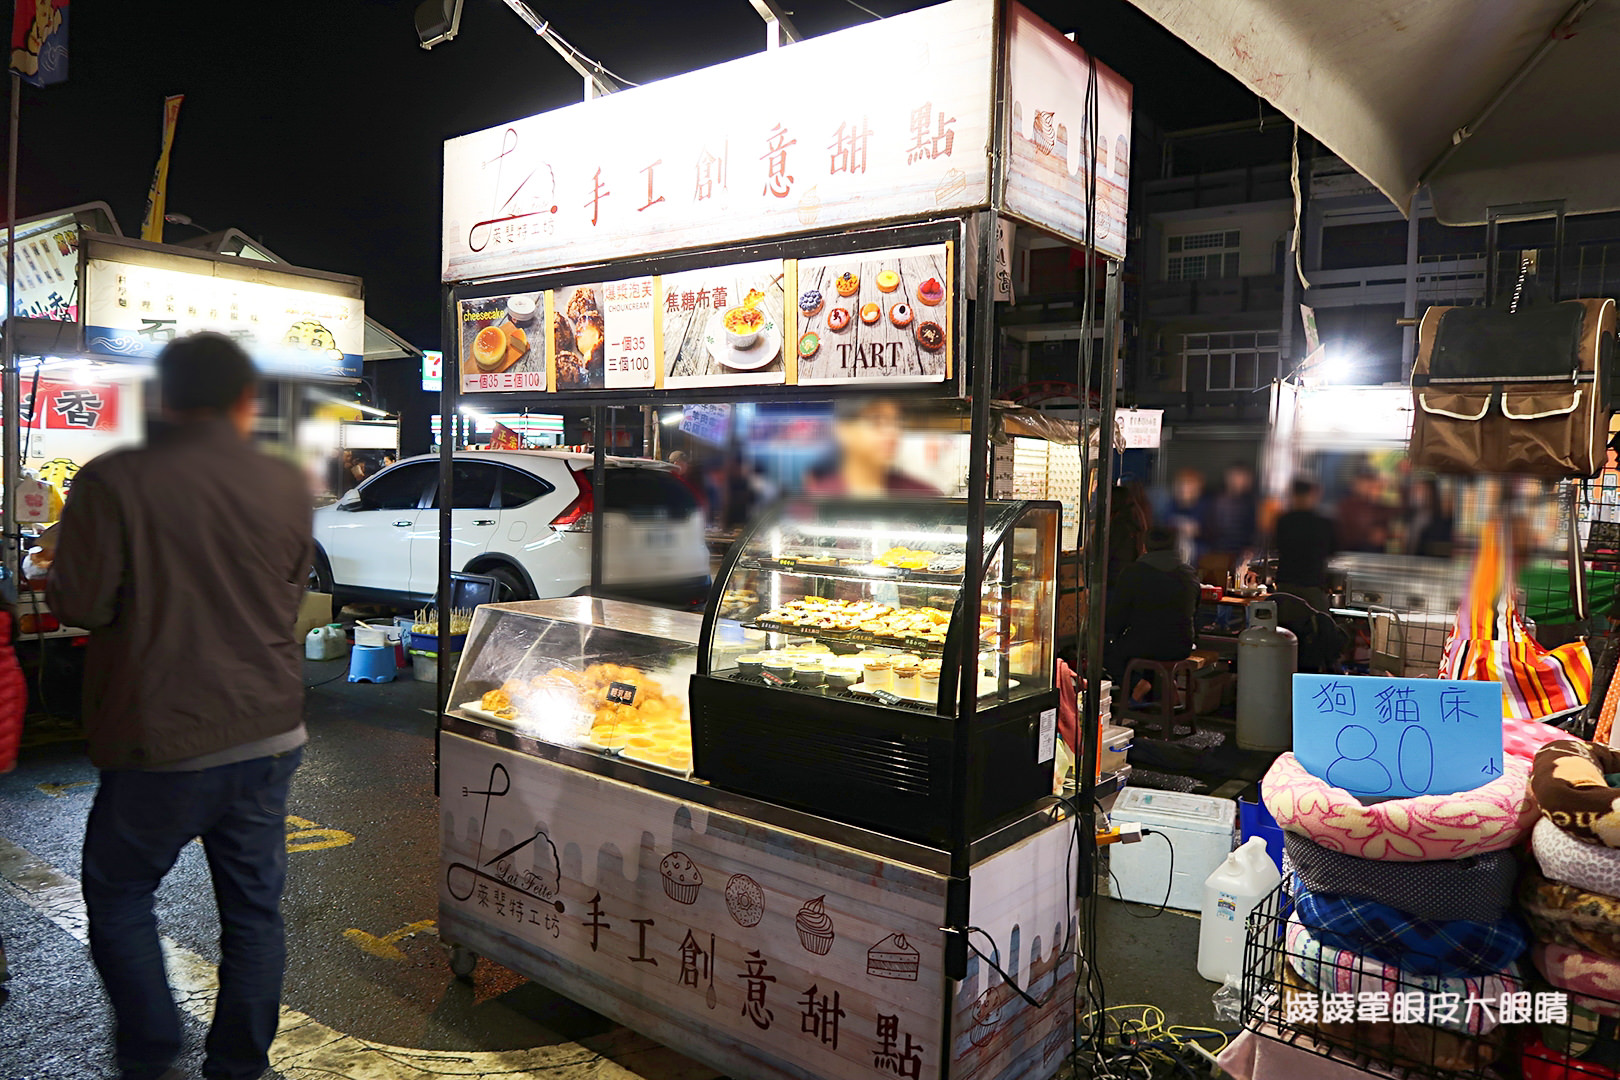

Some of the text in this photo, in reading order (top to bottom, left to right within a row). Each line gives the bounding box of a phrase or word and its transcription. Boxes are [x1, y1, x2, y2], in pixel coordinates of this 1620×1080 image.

[584, 101, 957, 227] 手工創意甜點
[666, 286, 728, 313] 焦糖布蕾
[463, 308, 505, 322] cheesecake
[611, 336, 646, 352] 一個35
[836, 342, 903, 369] TART
[608, 356, 650, 371] 三個100
[469, 373, 540, 389] 一個35 三個100
[1312, 682, 1479, 723] 狗貓床
[1326, 725, 1434, 795] 80
[1481, 757, 1503, 776] 小
[582, 890, 924, 1080] 手工創意甜點
